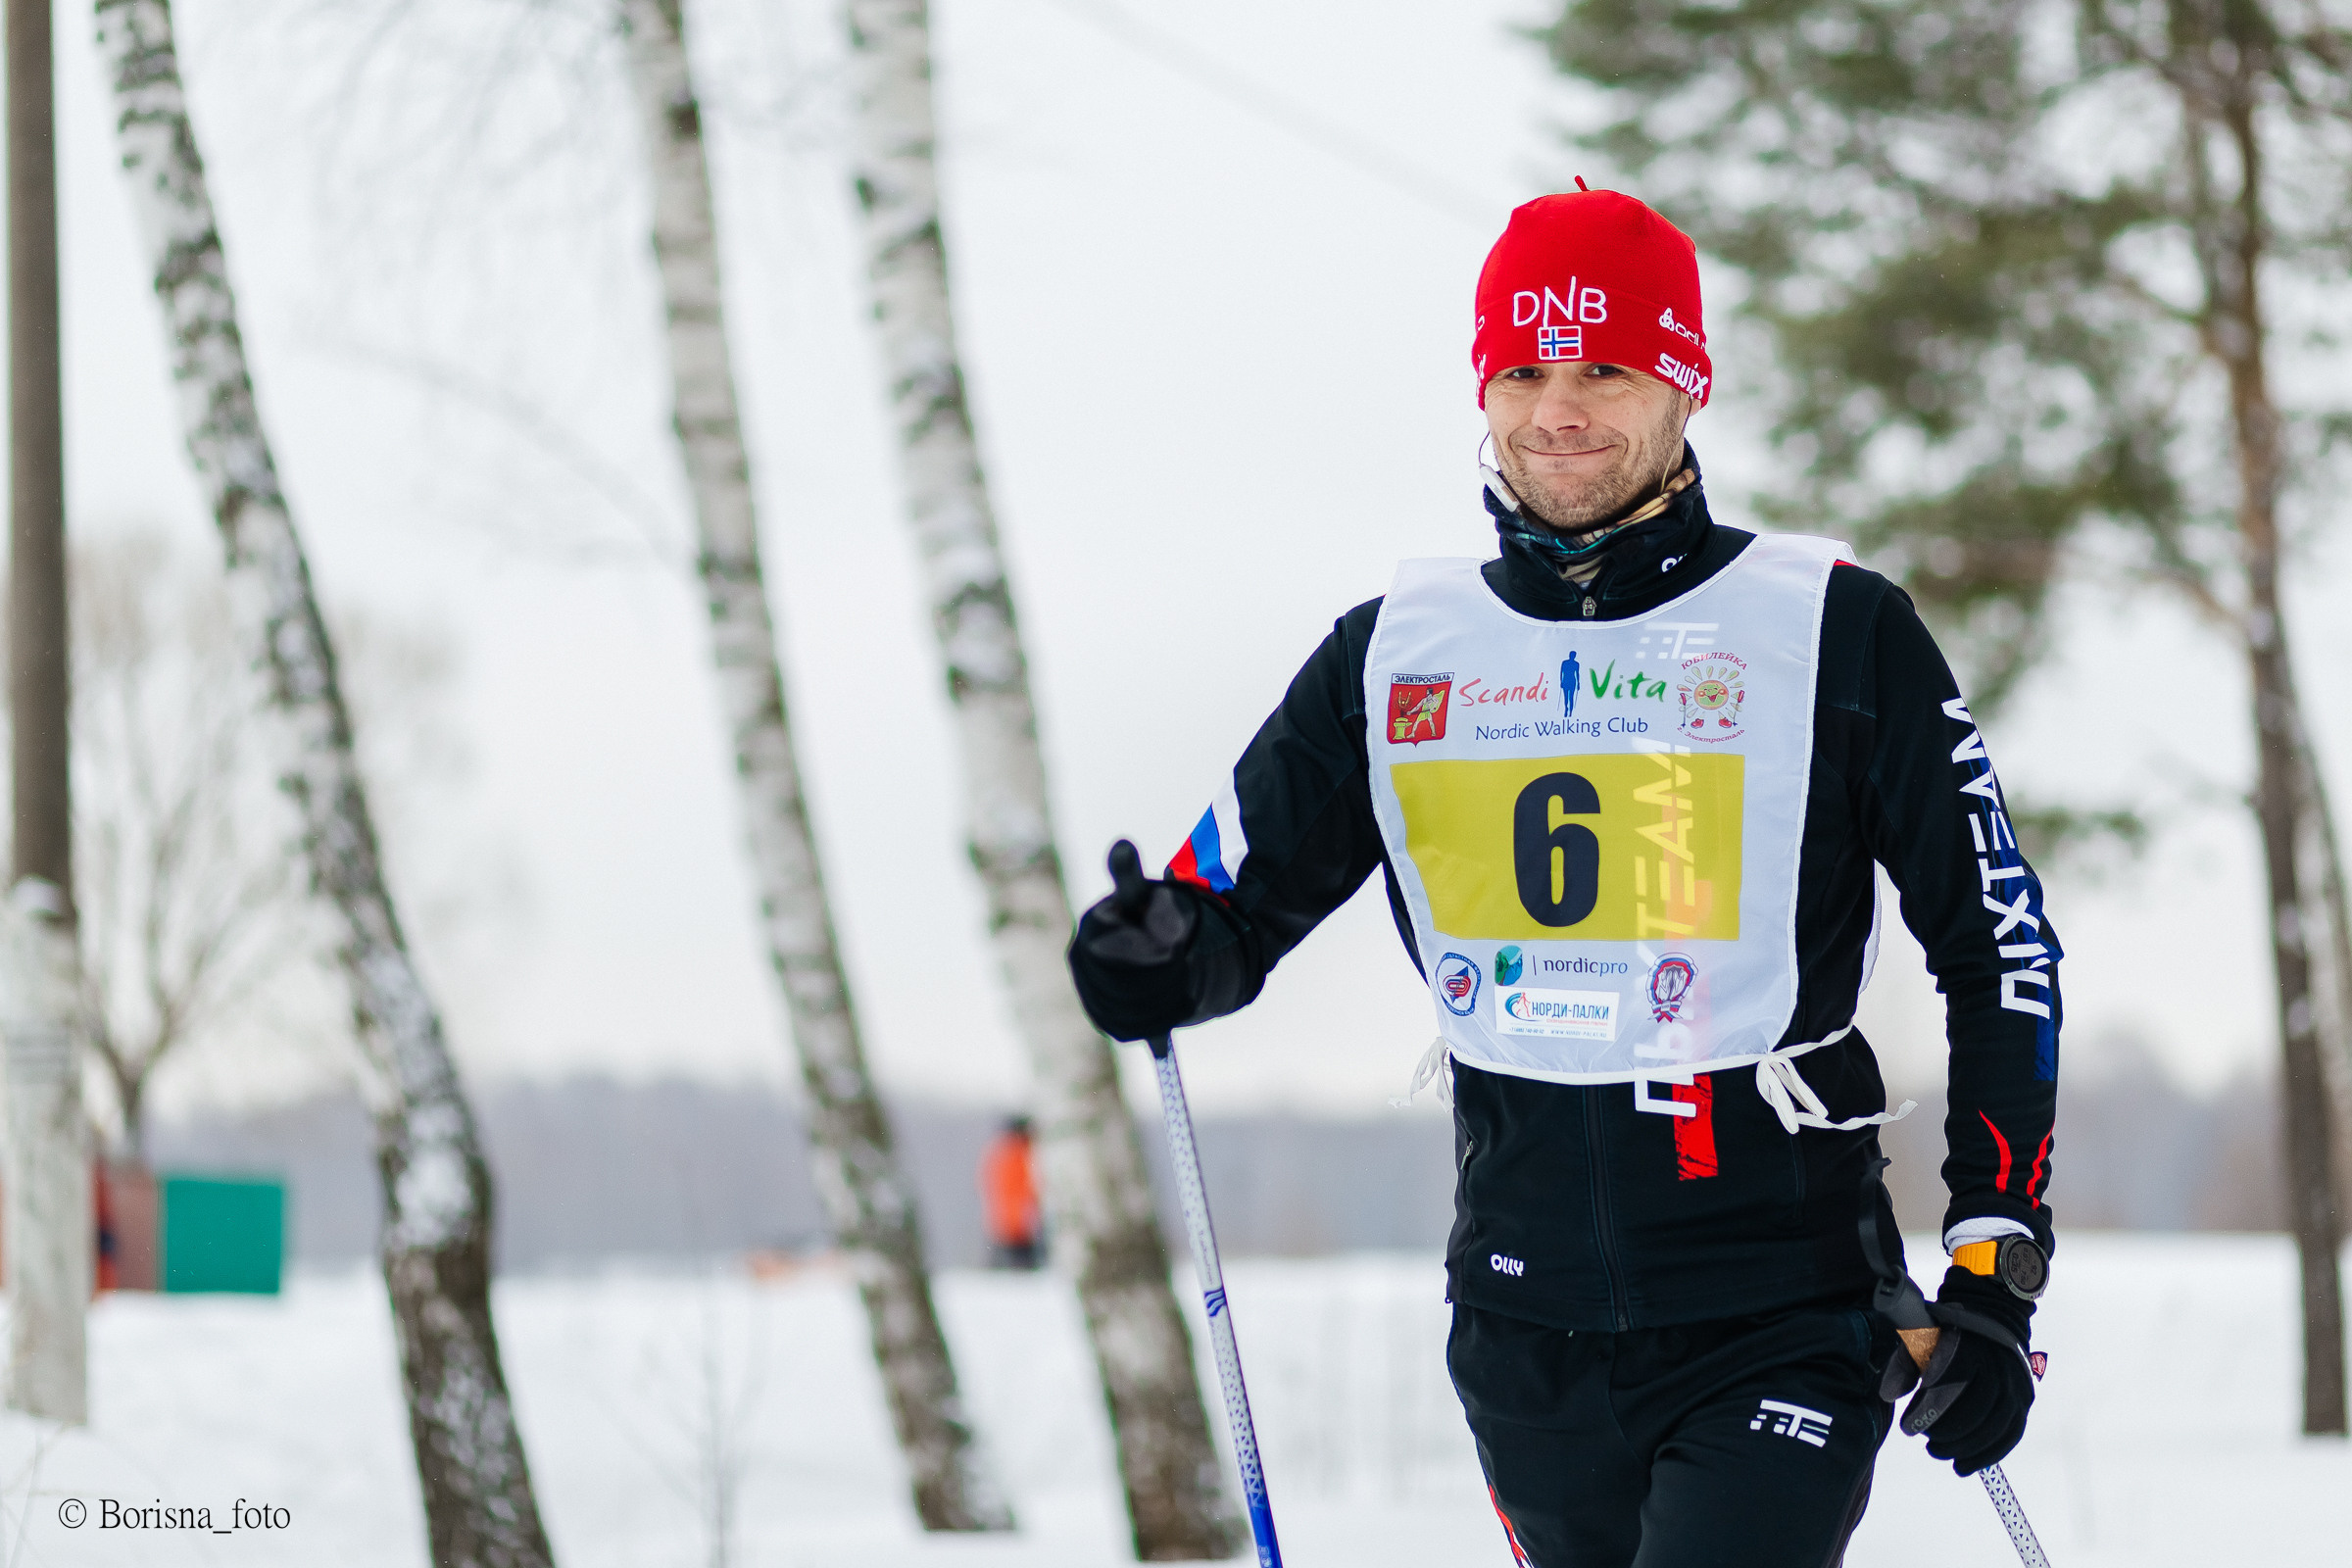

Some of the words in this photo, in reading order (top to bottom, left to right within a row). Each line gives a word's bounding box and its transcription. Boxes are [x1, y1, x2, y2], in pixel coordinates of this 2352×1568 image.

[1512, 275, 1608, 328] DNB
[1681, 652, 1748, 671] ЮБИЛЕЙКА
[1395, 674, 1450, 684] ЭЛЕКТРОСТАЛЬ
[1458, 671, 1549, 707] Scandi
[1589, 659, 1668, 703] Vita
[1475, 723, 1530, 740] Nordic
[1534, 718, 1601, 738] Walking
[1607, 716, 1649, 733] Club
[1513, 771, 1601, 928] 6
[1543, 957, 1629, 977] nordicpro
[1532, 1001, 1609, 1020] НОРДИ-ПАЛКИ
